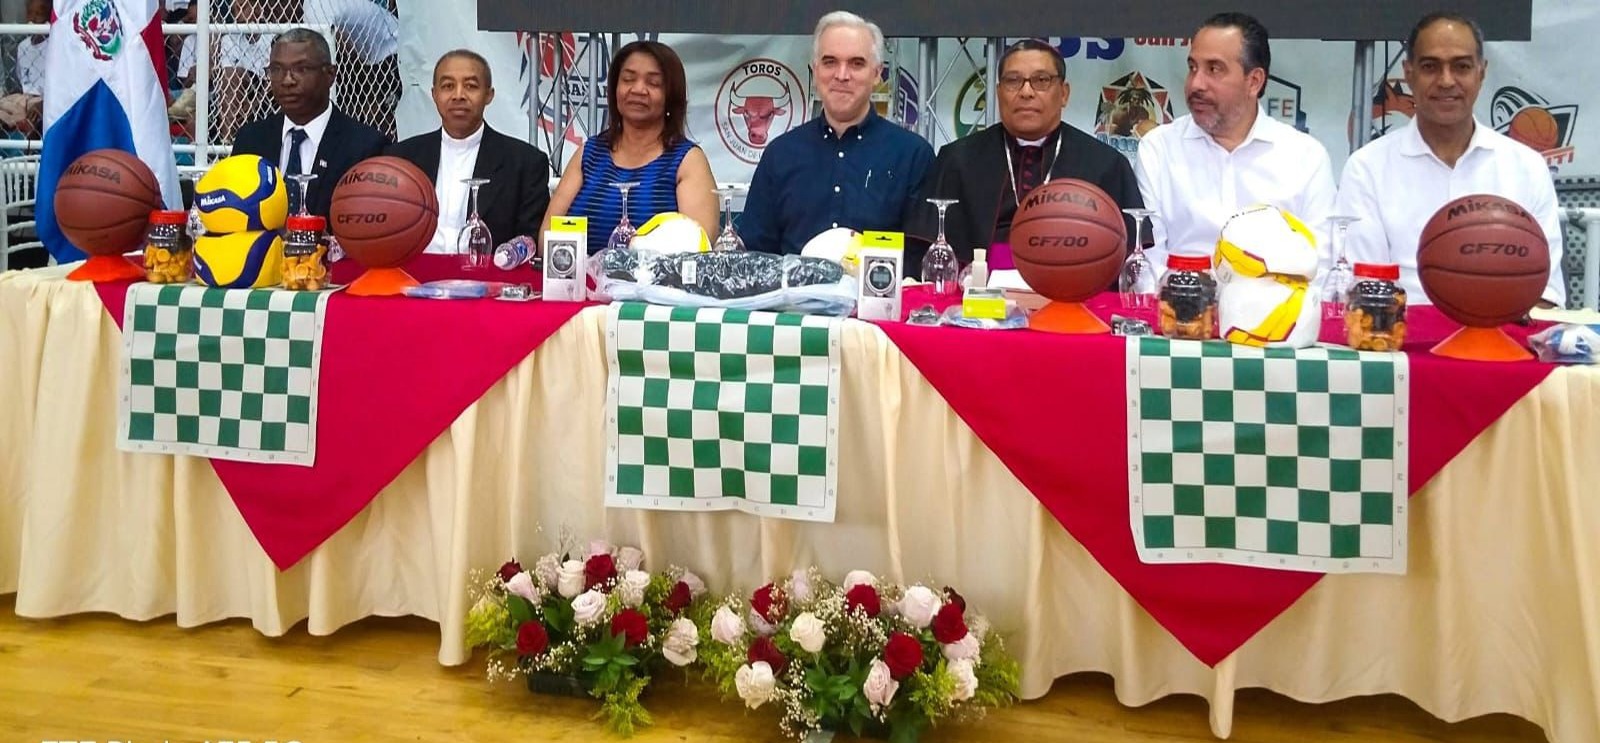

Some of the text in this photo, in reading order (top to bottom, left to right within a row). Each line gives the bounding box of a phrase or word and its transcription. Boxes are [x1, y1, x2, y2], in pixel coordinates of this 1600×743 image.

[743, 64, 781, 76] TOROS
[337, 213, 388, 224] CF700
[1028, 236, 1089, 248] CF700
[1459, 243, 1529, 257] CF700
